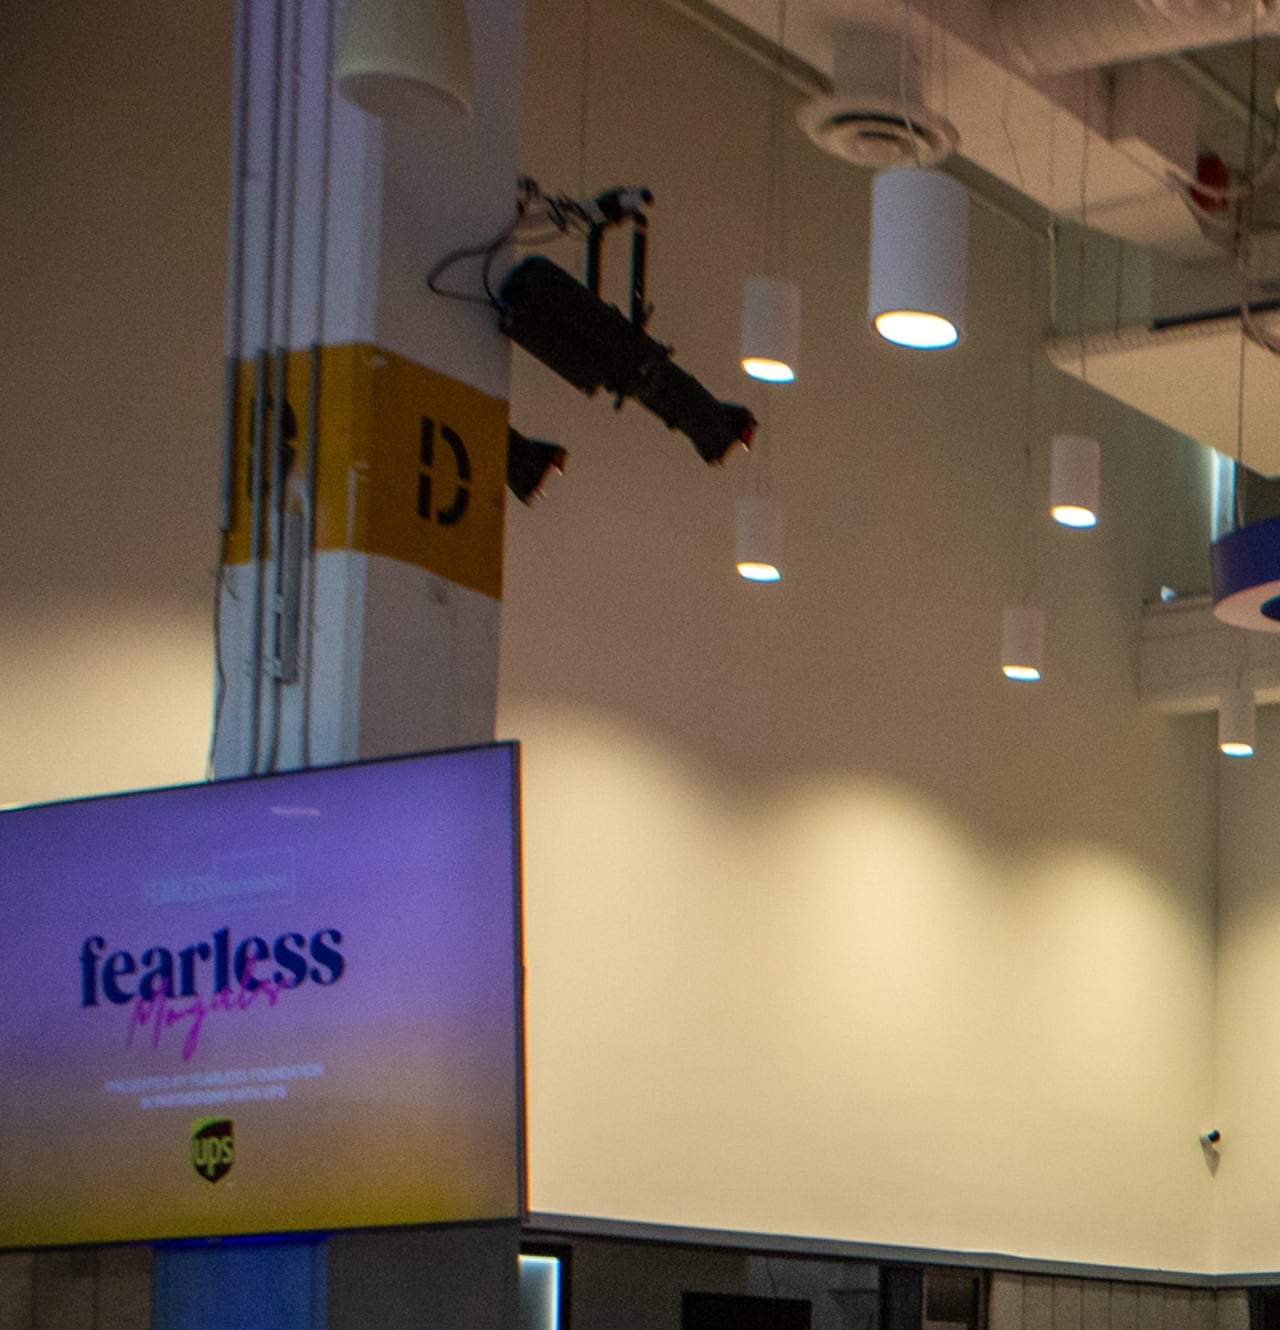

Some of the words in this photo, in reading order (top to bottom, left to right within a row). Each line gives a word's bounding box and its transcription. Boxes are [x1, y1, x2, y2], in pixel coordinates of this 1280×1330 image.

[416, 415, 472, 526] D
[80, 925, 346, 1008] fearless
[192, 1136, 236, 1177] ups
